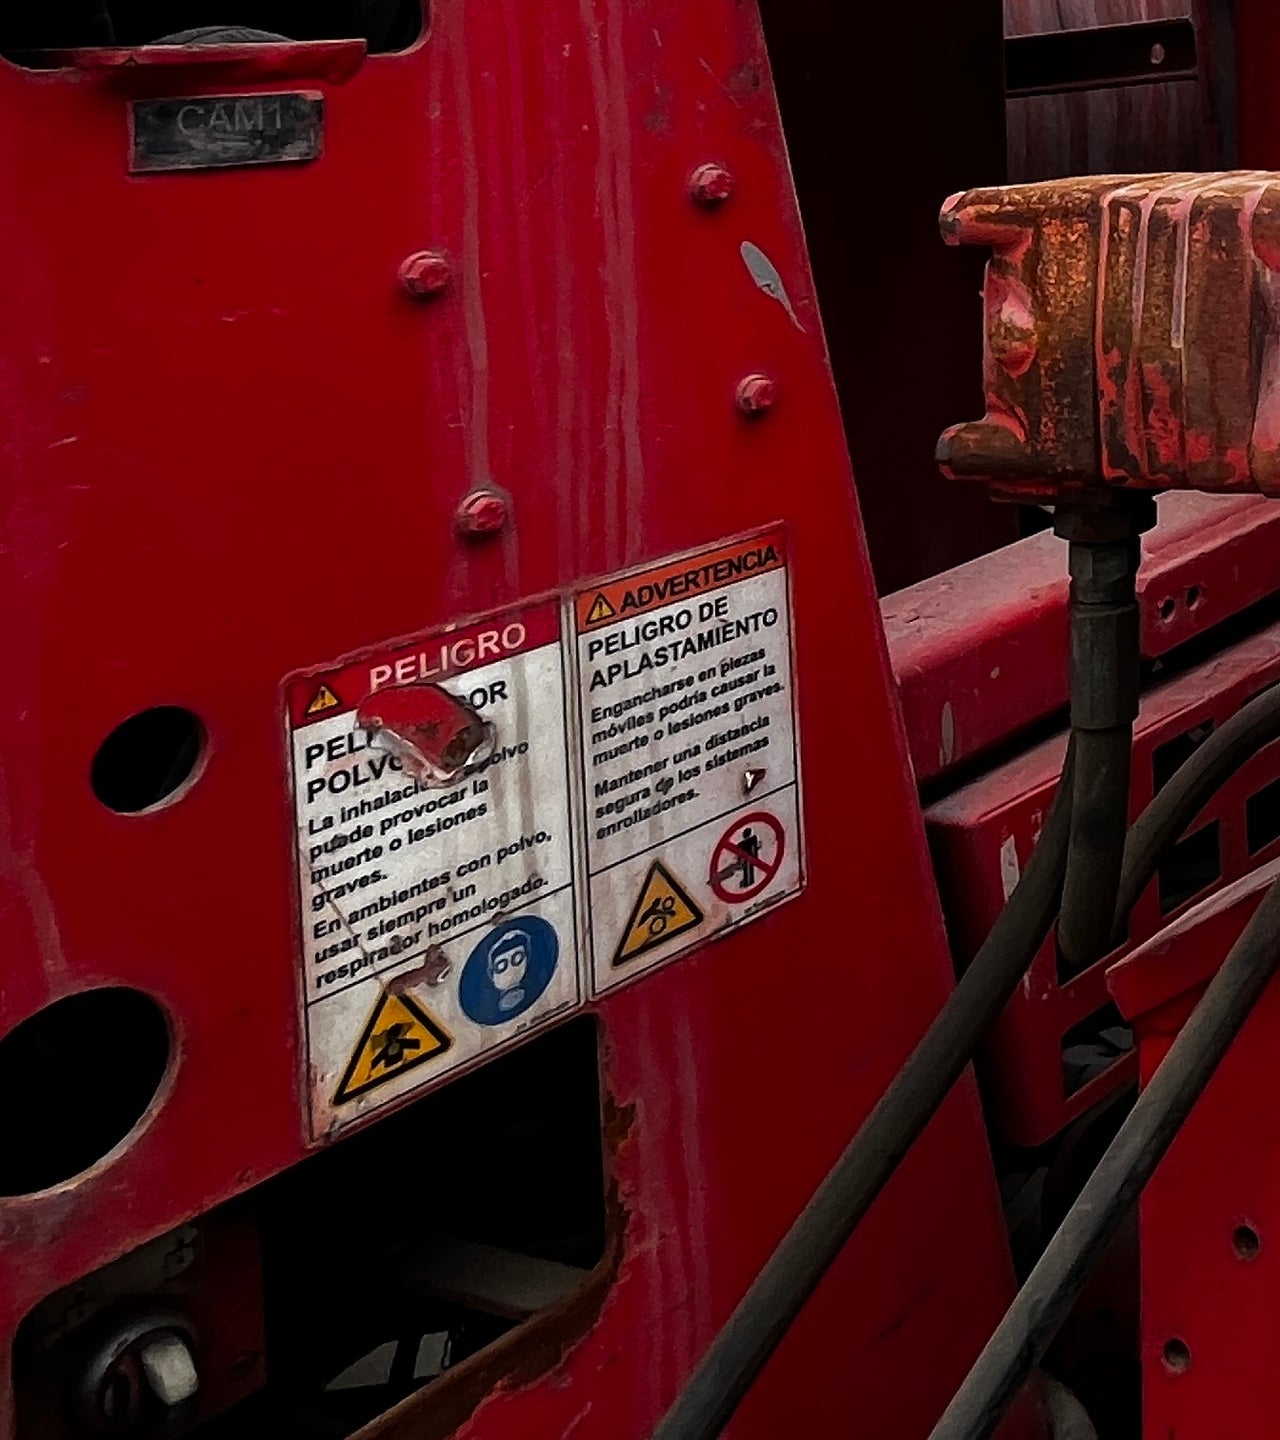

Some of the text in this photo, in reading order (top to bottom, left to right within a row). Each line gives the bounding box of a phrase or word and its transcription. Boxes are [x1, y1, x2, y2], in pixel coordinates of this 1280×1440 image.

[620, 544, 778, 613] ADVERTENCIA
[369, 623, 526, 693] PELIGRO
[588, 596, 728, 662] PELIGRO DE
[589, 608, 778, 692] APLASTAMIENTO
[591, 648, 765, 723] Engancharse en piezas
[592, 664, 776, 744] móviles podría causar la
[593, 681, 785, 766] muerte o lesiones graves.
[594, 716, 770, 798] Mantener una distancia
[595, 786, 650, 819] segura
[678, 763, 700, 783] los
[706, 736, 769, 771] sistemas
[309, 779, 488, 863] puede provocar la
[309, 815, 334, 835] La
[311, 802, 487, 884] muerte o lesiones
[597, 788, 699, 839] enrolladores.
[311, 868, 388, 912] graves.
[313, 919, 341, 939] En
[348, 870, 451, 926] ambientes
[456, 852, 491, 878] con
[315, 884, 477, 964] usar siempre un
[428, 875, 548, 938] homologado.
